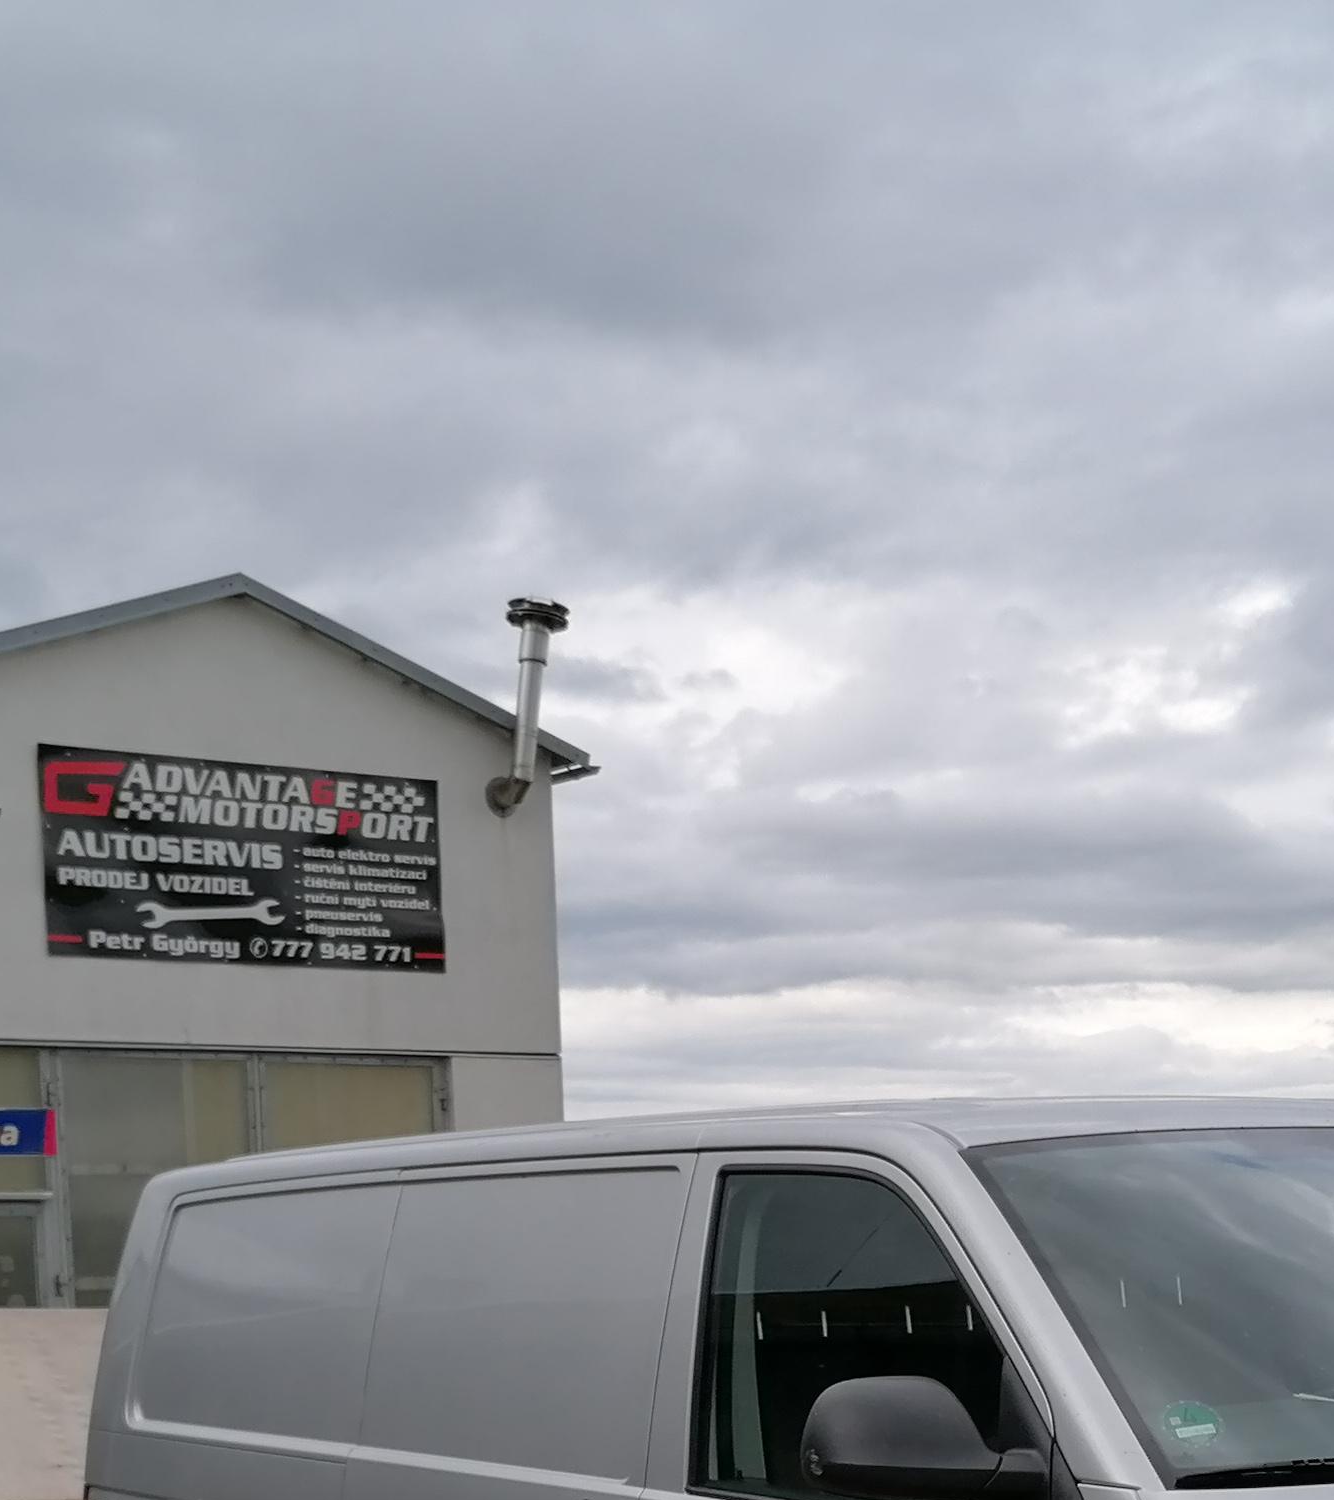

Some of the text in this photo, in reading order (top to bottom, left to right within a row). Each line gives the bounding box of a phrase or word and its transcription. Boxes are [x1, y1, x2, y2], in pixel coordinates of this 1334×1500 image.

[122, 763, 359, 810] ADVANTAGE
[177, 797, 435, 843] MOTORSPORT
[57, 830, 283, 870] AUTOSERVIS
[302, 847, 437, 866] auto elektro servis
[57, 866, 255, 897] PRODEJ VOZIDEL
[303, 862, 346, 875] servis
[305, 909, 384, 923] pneuservis
[305, 923, 391, 938] diagnostika
[88, 929, 412, 963] Petr György 777 942 771
